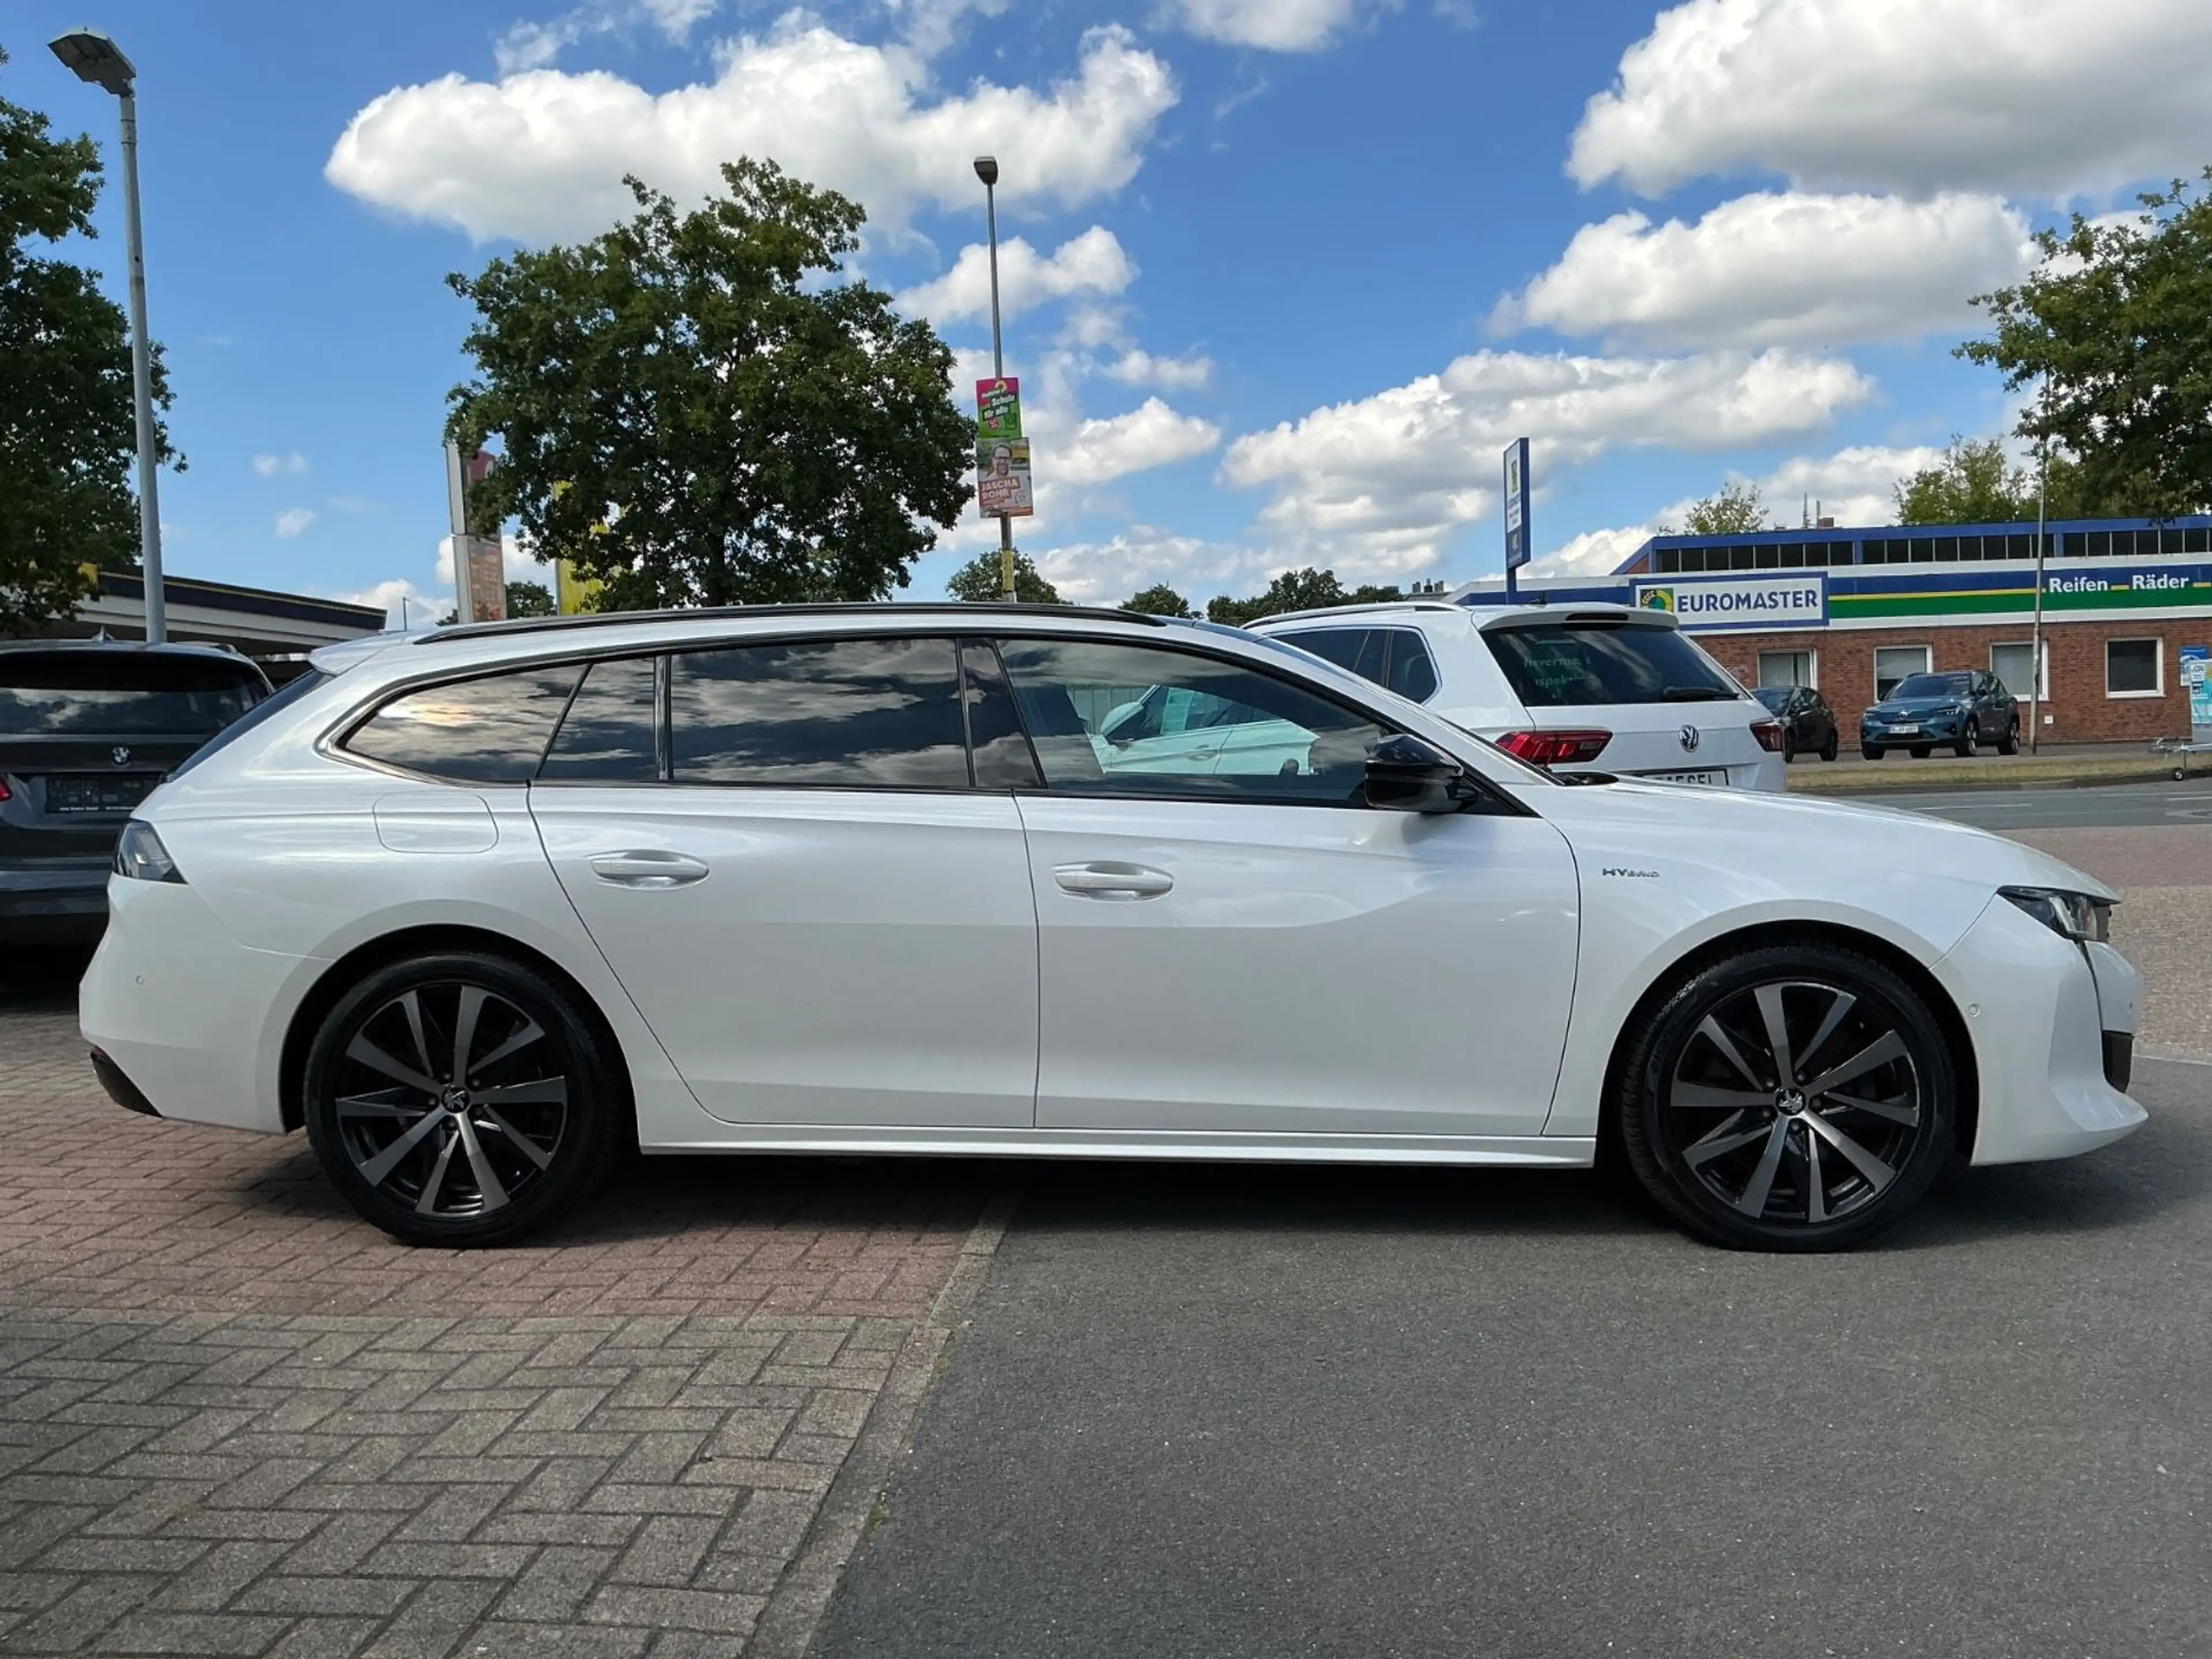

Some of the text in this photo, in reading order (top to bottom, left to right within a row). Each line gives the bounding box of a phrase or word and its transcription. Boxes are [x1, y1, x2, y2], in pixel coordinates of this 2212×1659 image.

[2048, 574, 2189, 593] Reifen Räder
[1677, 589, 1818, 613] EUROMASTER
